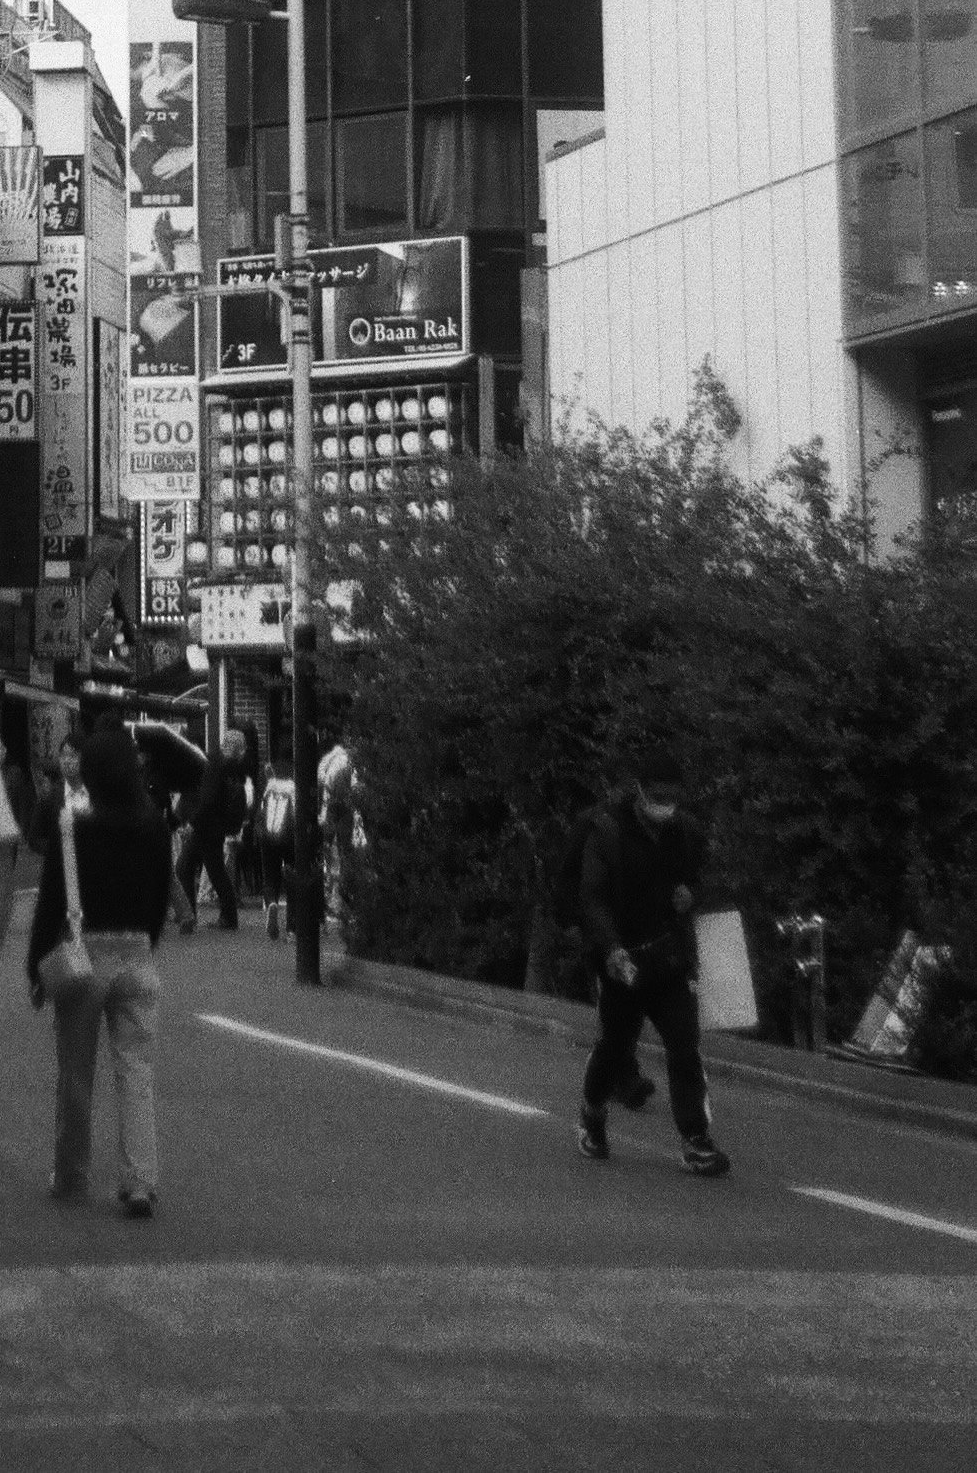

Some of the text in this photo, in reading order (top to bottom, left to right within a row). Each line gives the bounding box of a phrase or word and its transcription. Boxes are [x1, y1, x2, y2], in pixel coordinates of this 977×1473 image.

[145, 110, 180, 122] アロマ
[374, 316, 458, 343] Baan Rak
[237, 343, 256, 363] 3F
[132, 386, 194, 404] PIZZA
[132, 407, 161, 420] ALL
[132, 420, 195, 446] 500
[151, 501, 178, 560] オケ
[151, 596, 182, 613] OK
